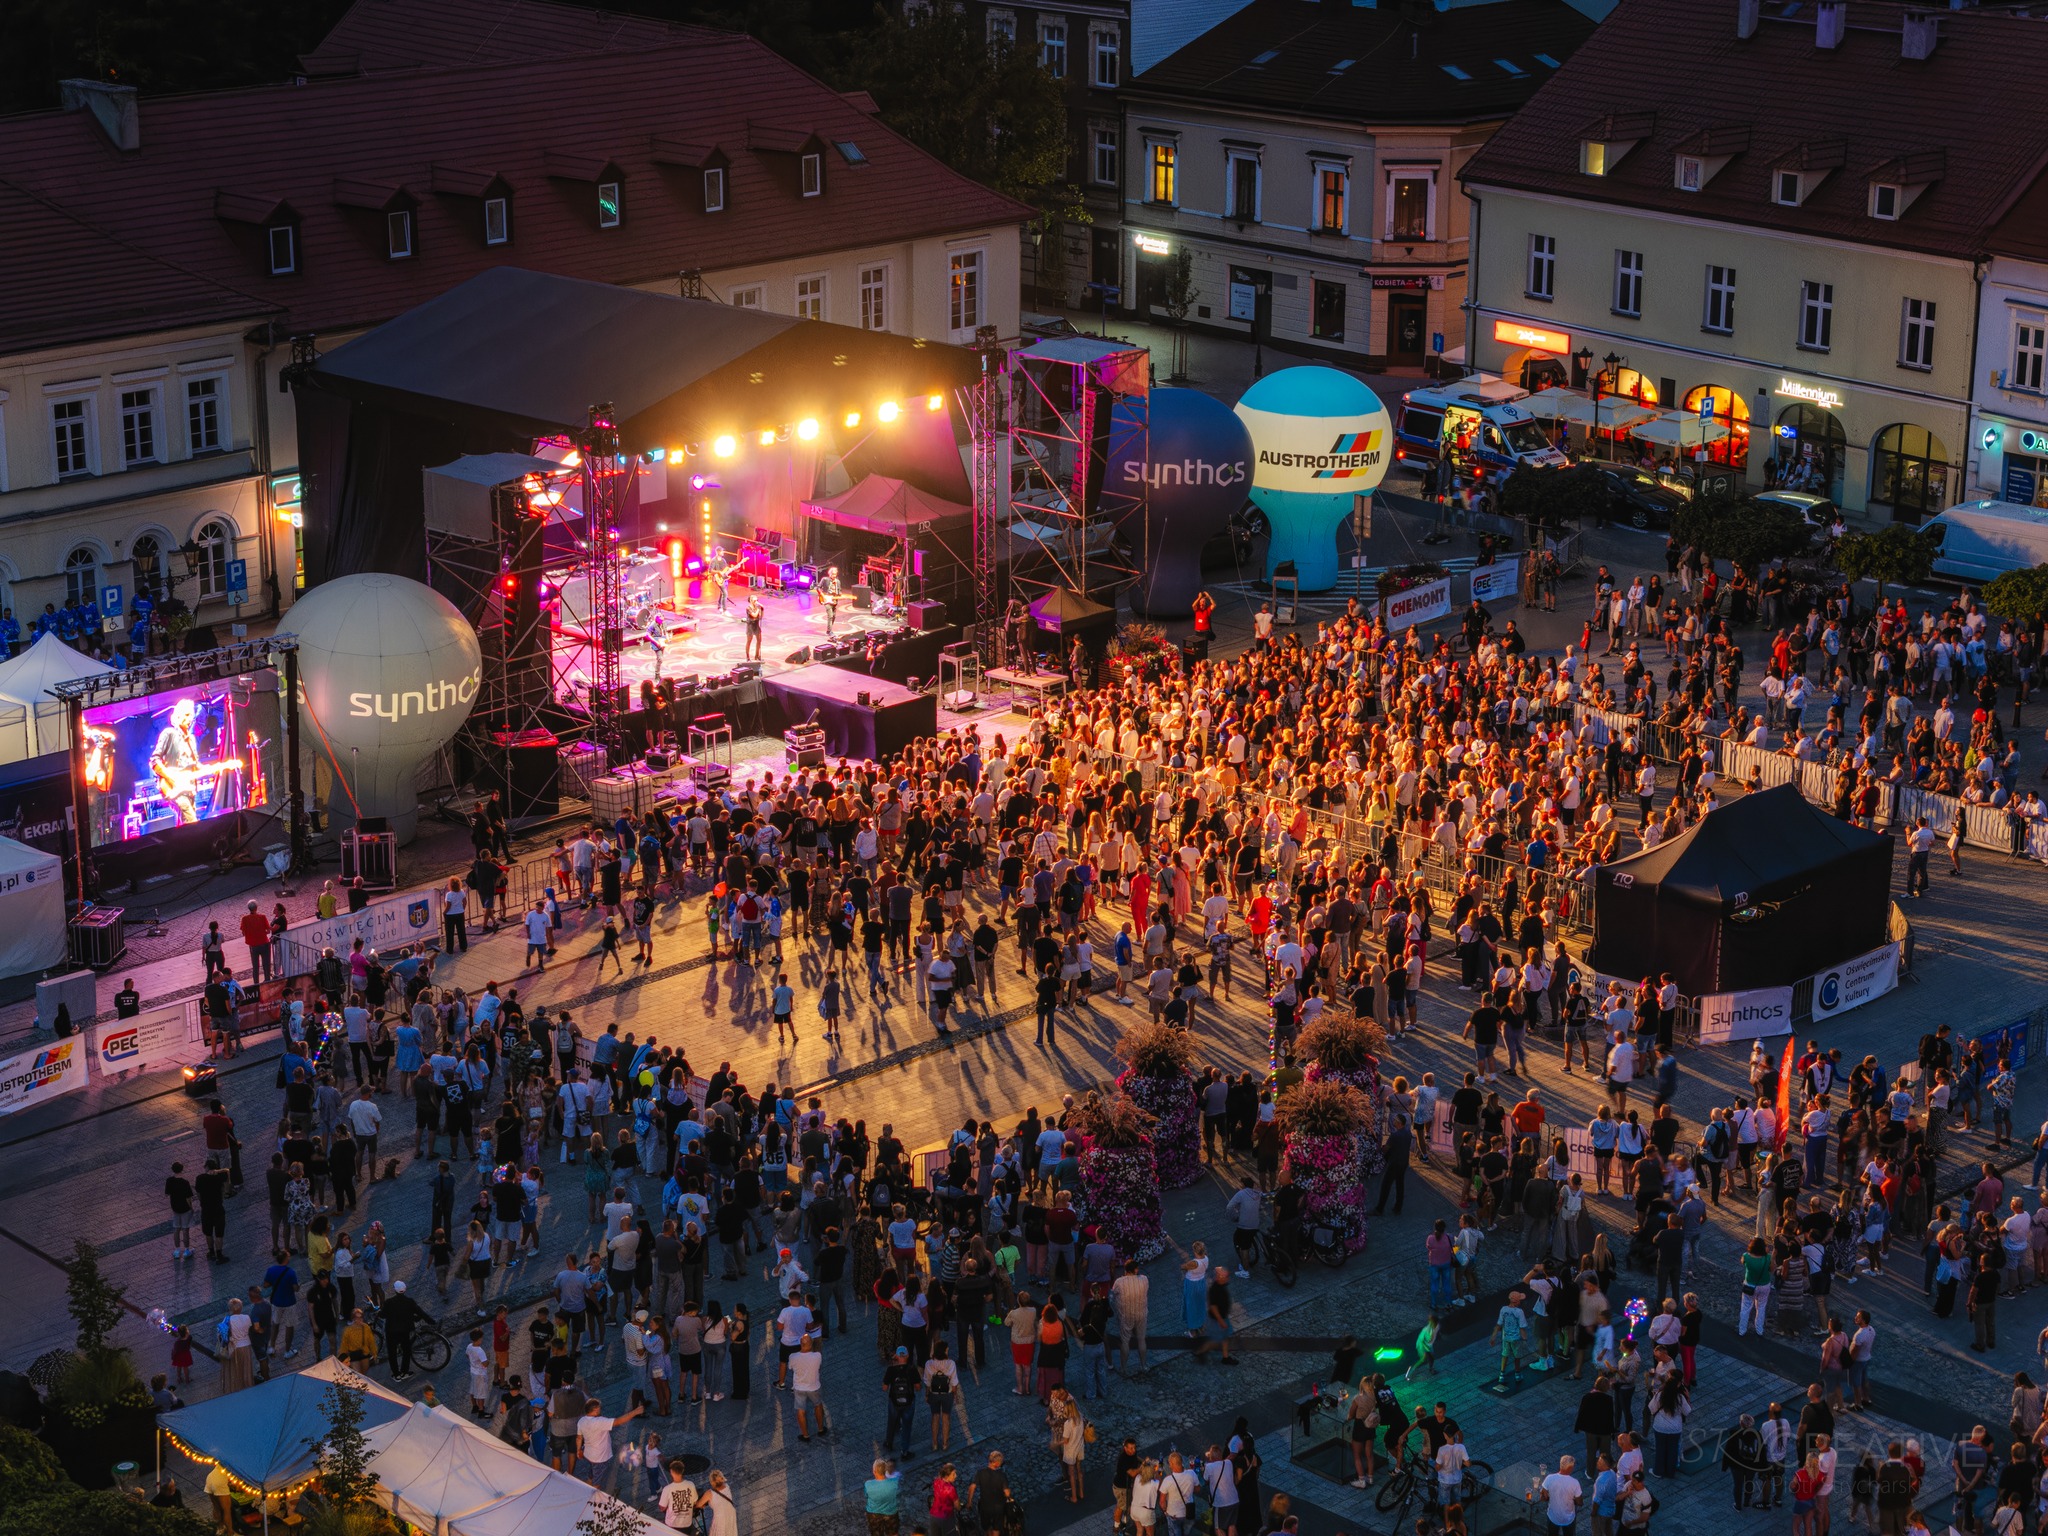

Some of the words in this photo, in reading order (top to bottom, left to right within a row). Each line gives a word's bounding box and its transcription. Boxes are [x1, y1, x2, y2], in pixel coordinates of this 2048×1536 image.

[1781, 378, 1838, 402] Millennium
[1703, 399, 1712, 416] P
[1259, 450, 1381, 469] AUSTROTHERM
[1123, 458, 1246, 489] synthos
[230, 562, 243, 582] P
[1476, 578, 1492, 590] PEC
[106, 588, 118, 608] P
[1390, 587, 1446, 618] CHEMONT
[350, 665, 480, 723] synthos
[312, 911, 396, 945] OŚWIĘCIM
[1845, 950, 1892, 976] Oświęcimskie
[1844, 971, 1875, 990] Centrum
[1844, 985, 1871, 1004] Kultury
[1710, 1004, 1784, 1026] synthos
[110, 1035, 139, 1055] PEC
[503, 1036, 517, 1048] 30
